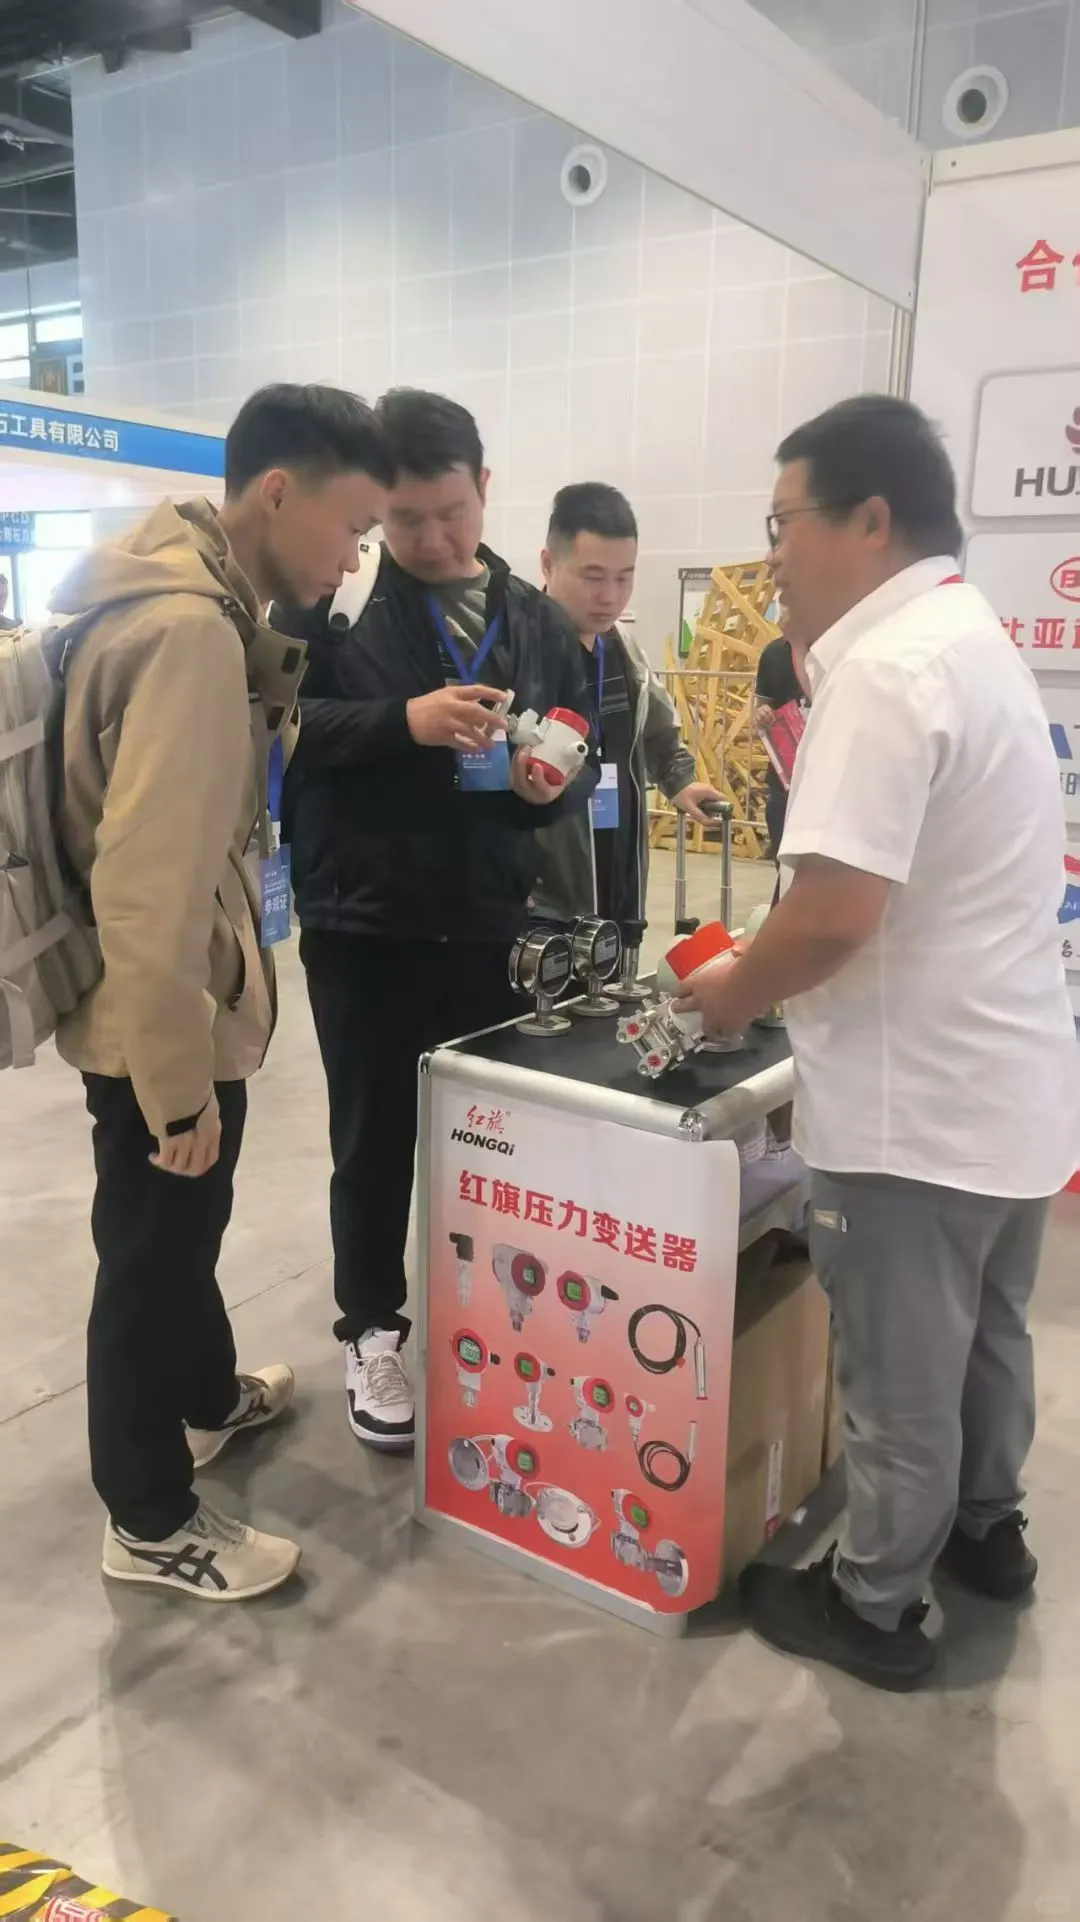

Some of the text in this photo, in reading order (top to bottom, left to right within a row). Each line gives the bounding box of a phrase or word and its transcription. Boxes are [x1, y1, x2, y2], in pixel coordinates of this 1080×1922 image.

[1014, 465, 1080, 498] HU
[459, 1169, 698, 1273] 红旗压力变送器
